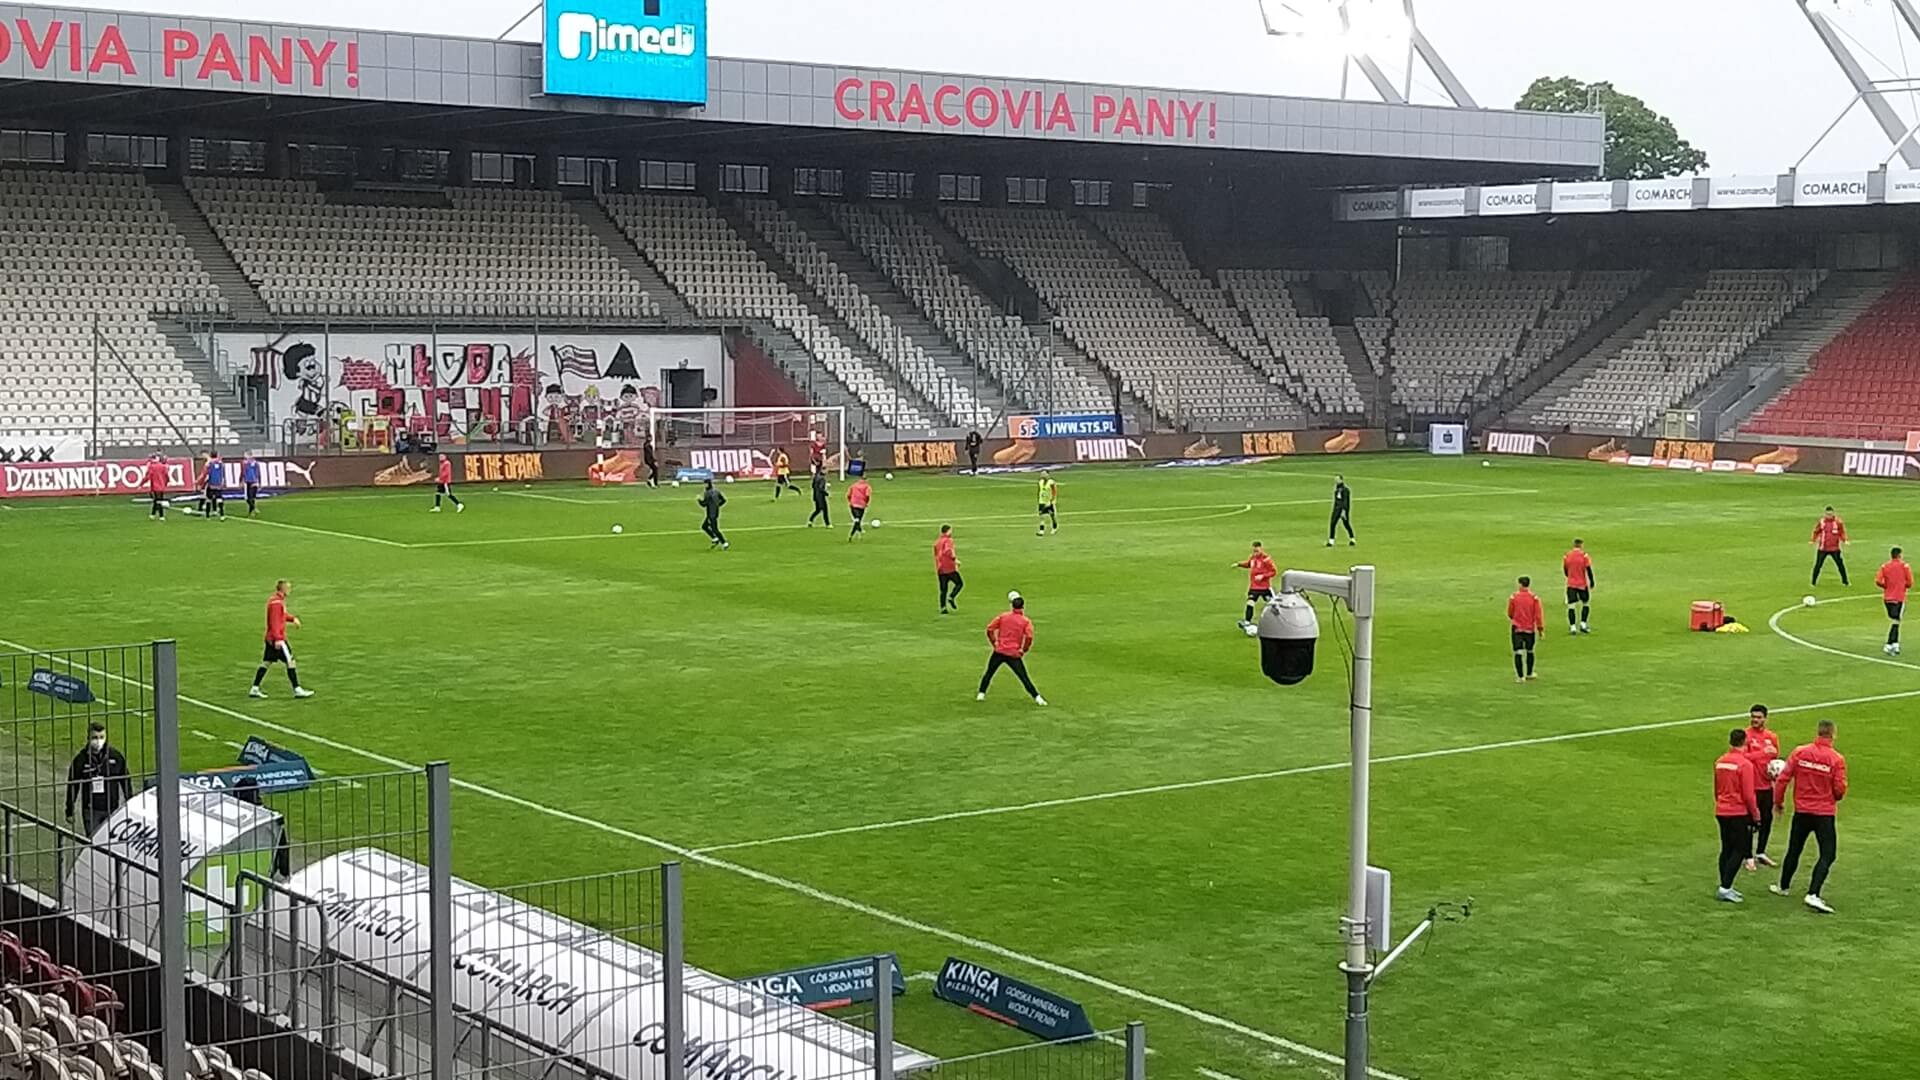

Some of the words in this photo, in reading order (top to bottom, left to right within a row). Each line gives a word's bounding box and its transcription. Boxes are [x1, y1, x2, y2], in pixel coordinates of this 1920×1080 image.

[0, 19, 137, 75] VIA
[163, 29, 359, 88] PANY!
[834, 77, 1076, 132] CRACOVIA
[1092, 95, 1216, 140] PANY!
[1635, 188, 1691, 200] COMARCH
[1802, 182, 1866, 195] COMARCH
[1486, 194, 1537, 206] COMARCH
[1020, 419, 1039, 437] STS
[1045, 421, 1116, 434] WWW.STS.PL
[1075, 439, 1128, 460] PUMA
[1486, 432, 1536, 454] PUMA
[465, 454, 482, 480] BE
[481, 454, 504, 480] THE
[691, 449, 752, 472] PUMA
[1843, 452, 1905, 477] PUMA
[5, 466, 105, 492] DZIENNIK
[945, 962, 1000, 997] KINGA
